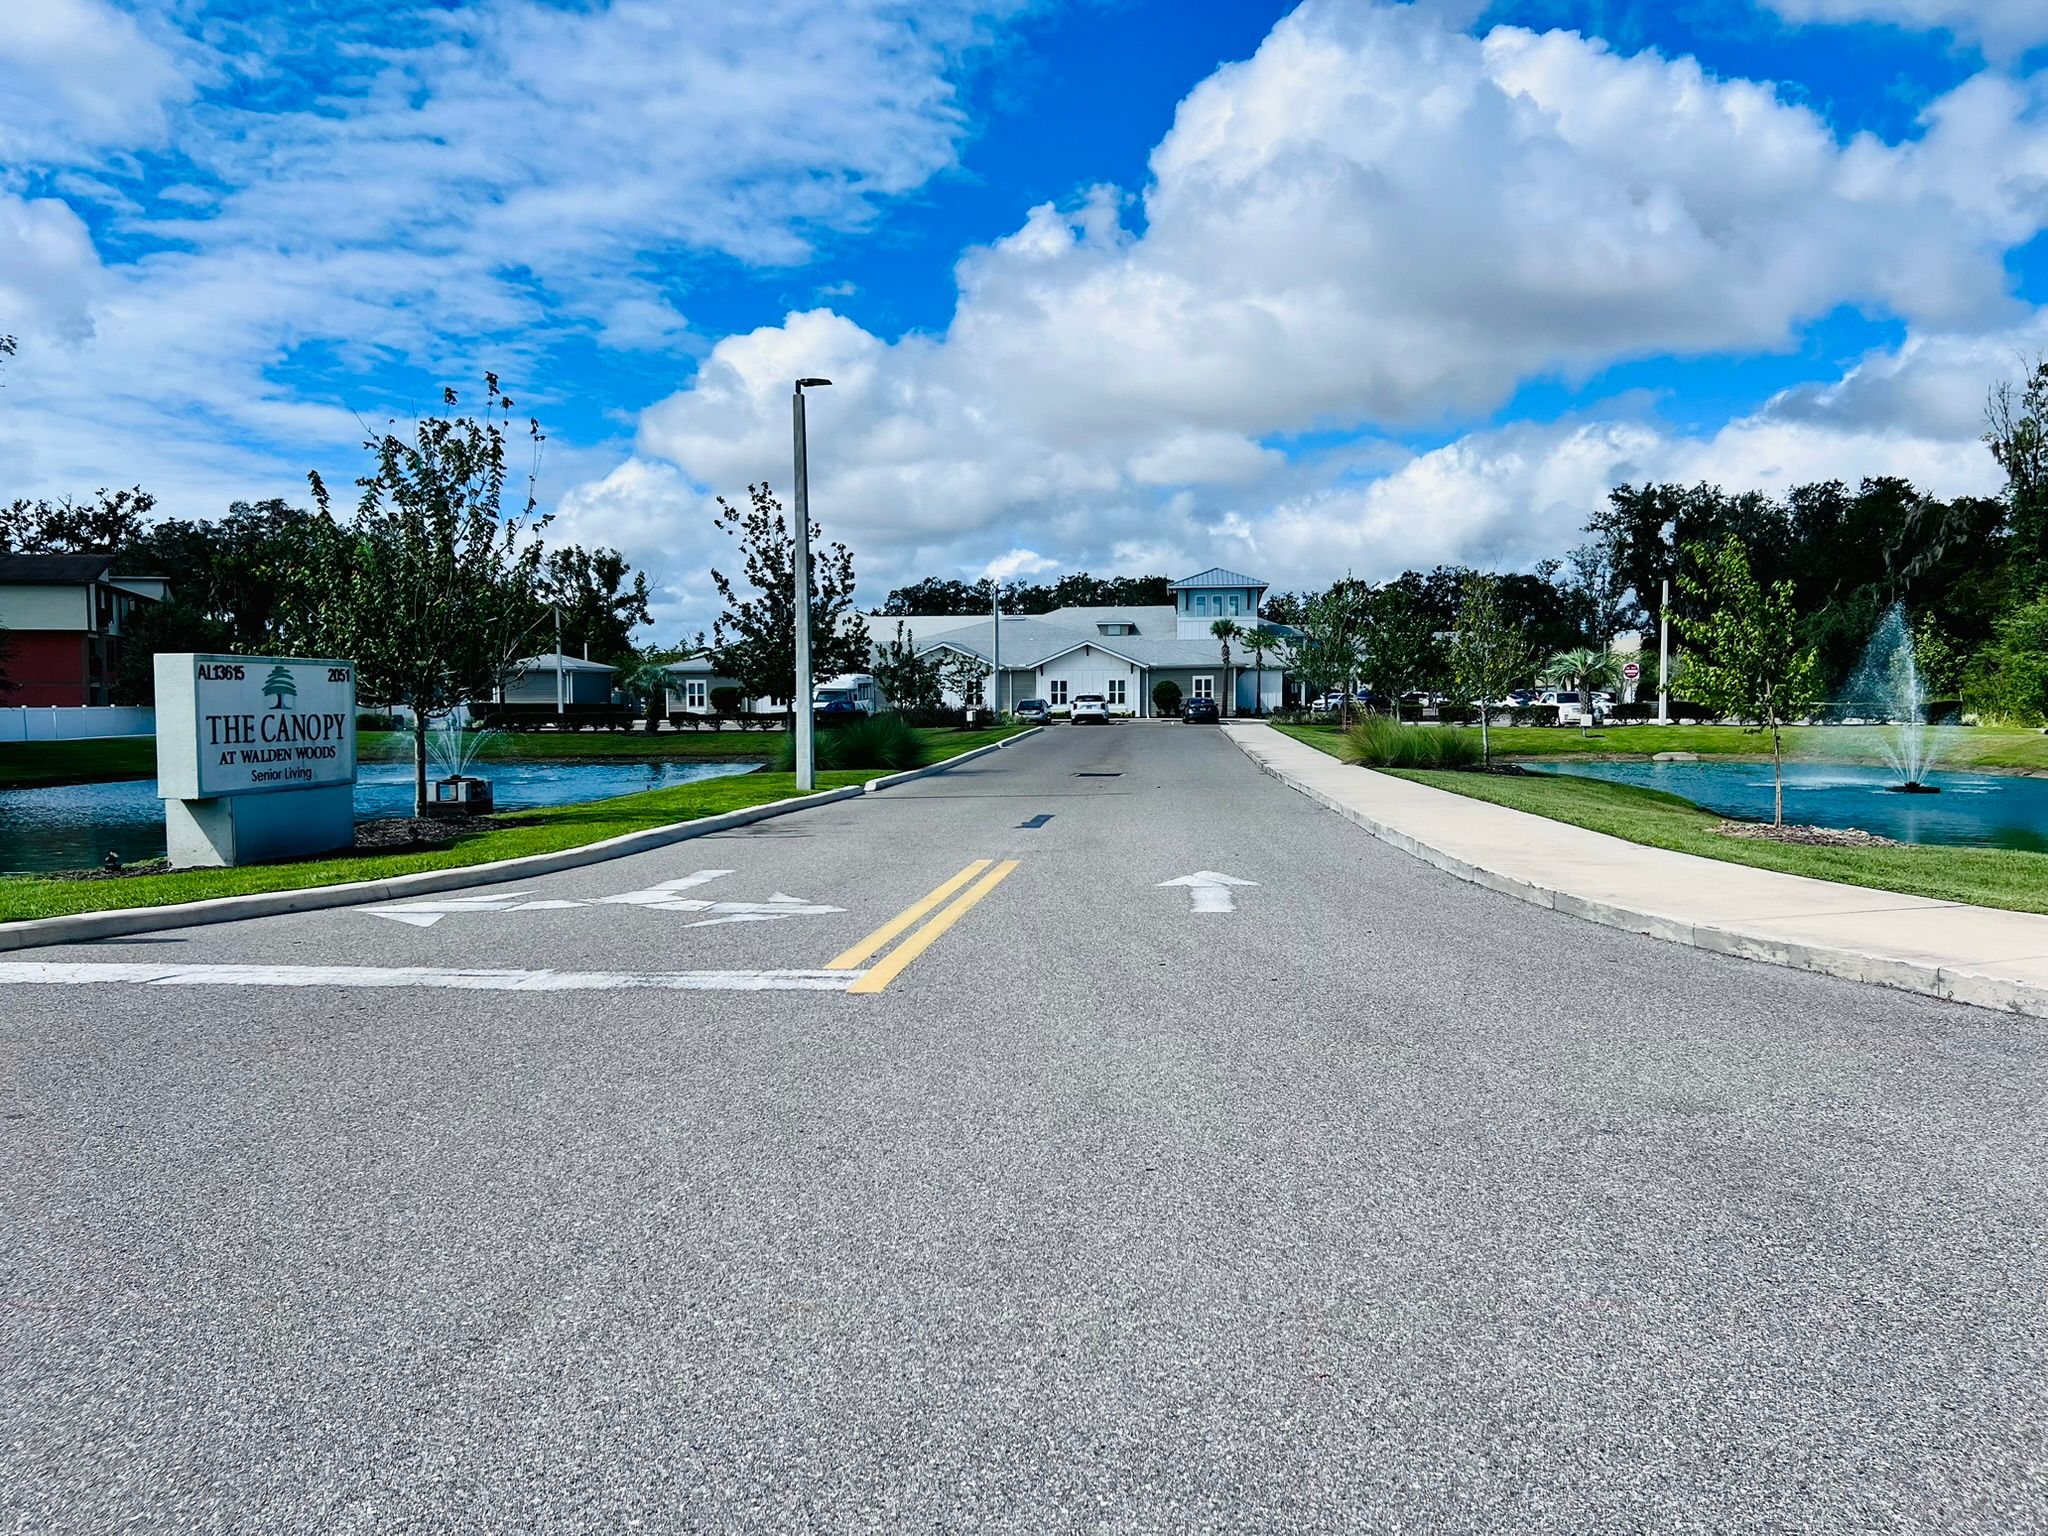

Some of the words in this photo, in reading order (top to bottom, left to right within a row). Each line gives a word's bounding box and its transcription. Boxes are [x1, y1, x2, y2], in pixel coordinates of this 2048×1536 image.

[198, 664, 245, 681] AL13615
[328, 668, 350, 682] 2051
[206, 715, 256, 745] THE
[261, 713, 346, 743] CANOPY
[219, 751, 237, 765] AT
[240, 748, 292, 763] WALDEN
[296, 746, 336, 760] WOODS
[252, 769, 282, 782] Senior
[285, 767, 312, 781] Living
